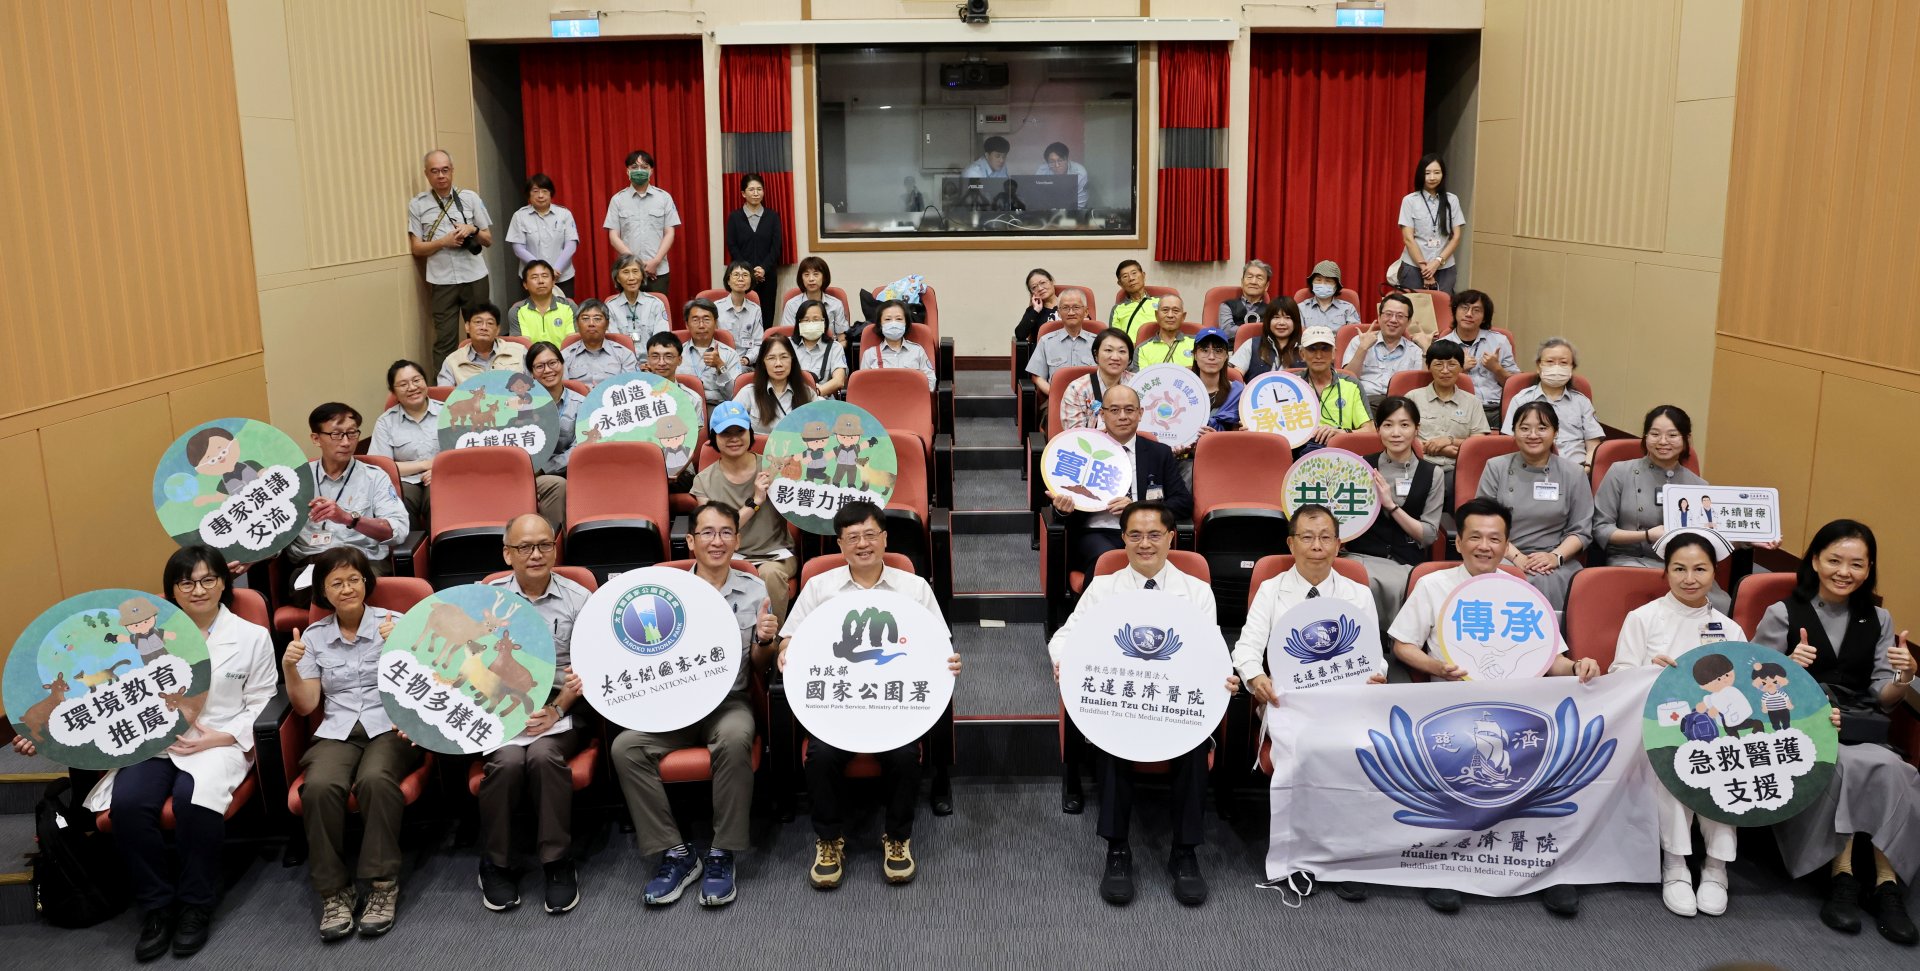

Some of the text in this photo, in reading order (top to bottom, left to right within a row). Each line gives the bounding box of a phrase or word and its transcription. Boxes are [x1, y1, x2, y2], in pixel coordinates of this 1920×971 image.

[610, 384, 646, 407] 創造
[599, 399, 670, 431] 永續價值
[1251, 401, 1314, 433] 承諾
[1052, 448, 1123, 496] 實踐
[208, 471, 291, 537] 專家演講
[1293, 481, 1370, 516] 共生
[1720, 506, 1766, 518] 永續醫療
[246, 506, 291, 545] 交流
[1726, 519, 1761, 530] 新時代
[1451, 598, 1545, 643] 傳承
[622, 622, 683, 653] TAROKO NATIONAL PARK
[809, 665, 849, 677] 內政部
[1085, 664, 1169, 681] 佛教慈濟醫療財團法人
[1293, 654, 1370, 684] 花蓮慈濟醫院
[1333, 673, 1344, 681] Chi
[60, 663, 178, 732] 環境教育
[605, 664, 729, 707] TAROKO NATIONAL PARK
[806, 680, 931, 703] 國家公園署
[1081, 675, 1205, 706] 花蓮慈濟醫院
[382, 659, 493, 747] 生物多樣性
[1079, 706, 1109, 716] Buddhist
[1124, 711, 1136, 719] Chi
[1138, 713, 1163, 722] Medical
[1164, 716, 1203, 727] Foundation
[1080, 695, 1206, 719] Hualien Tzu Chi Hospital,
[107, 703, 169, 749] 推廣
[1688, 736, 1803, 775] 急救醫護
[1724, 773, 1782, 806] 支援
[1400, 861, 1438, 870] Buddhist
[1440, 863, 1455, 871] Tzu
[1458, 865, 1472, 873] Chi
[1474, 867, 1506, 876] Medical
[1401, 850, 1448, 861] Hualien
[1451, 851, 1473, 862] Tzu
[1478, 854, 1499, 864] Chi
